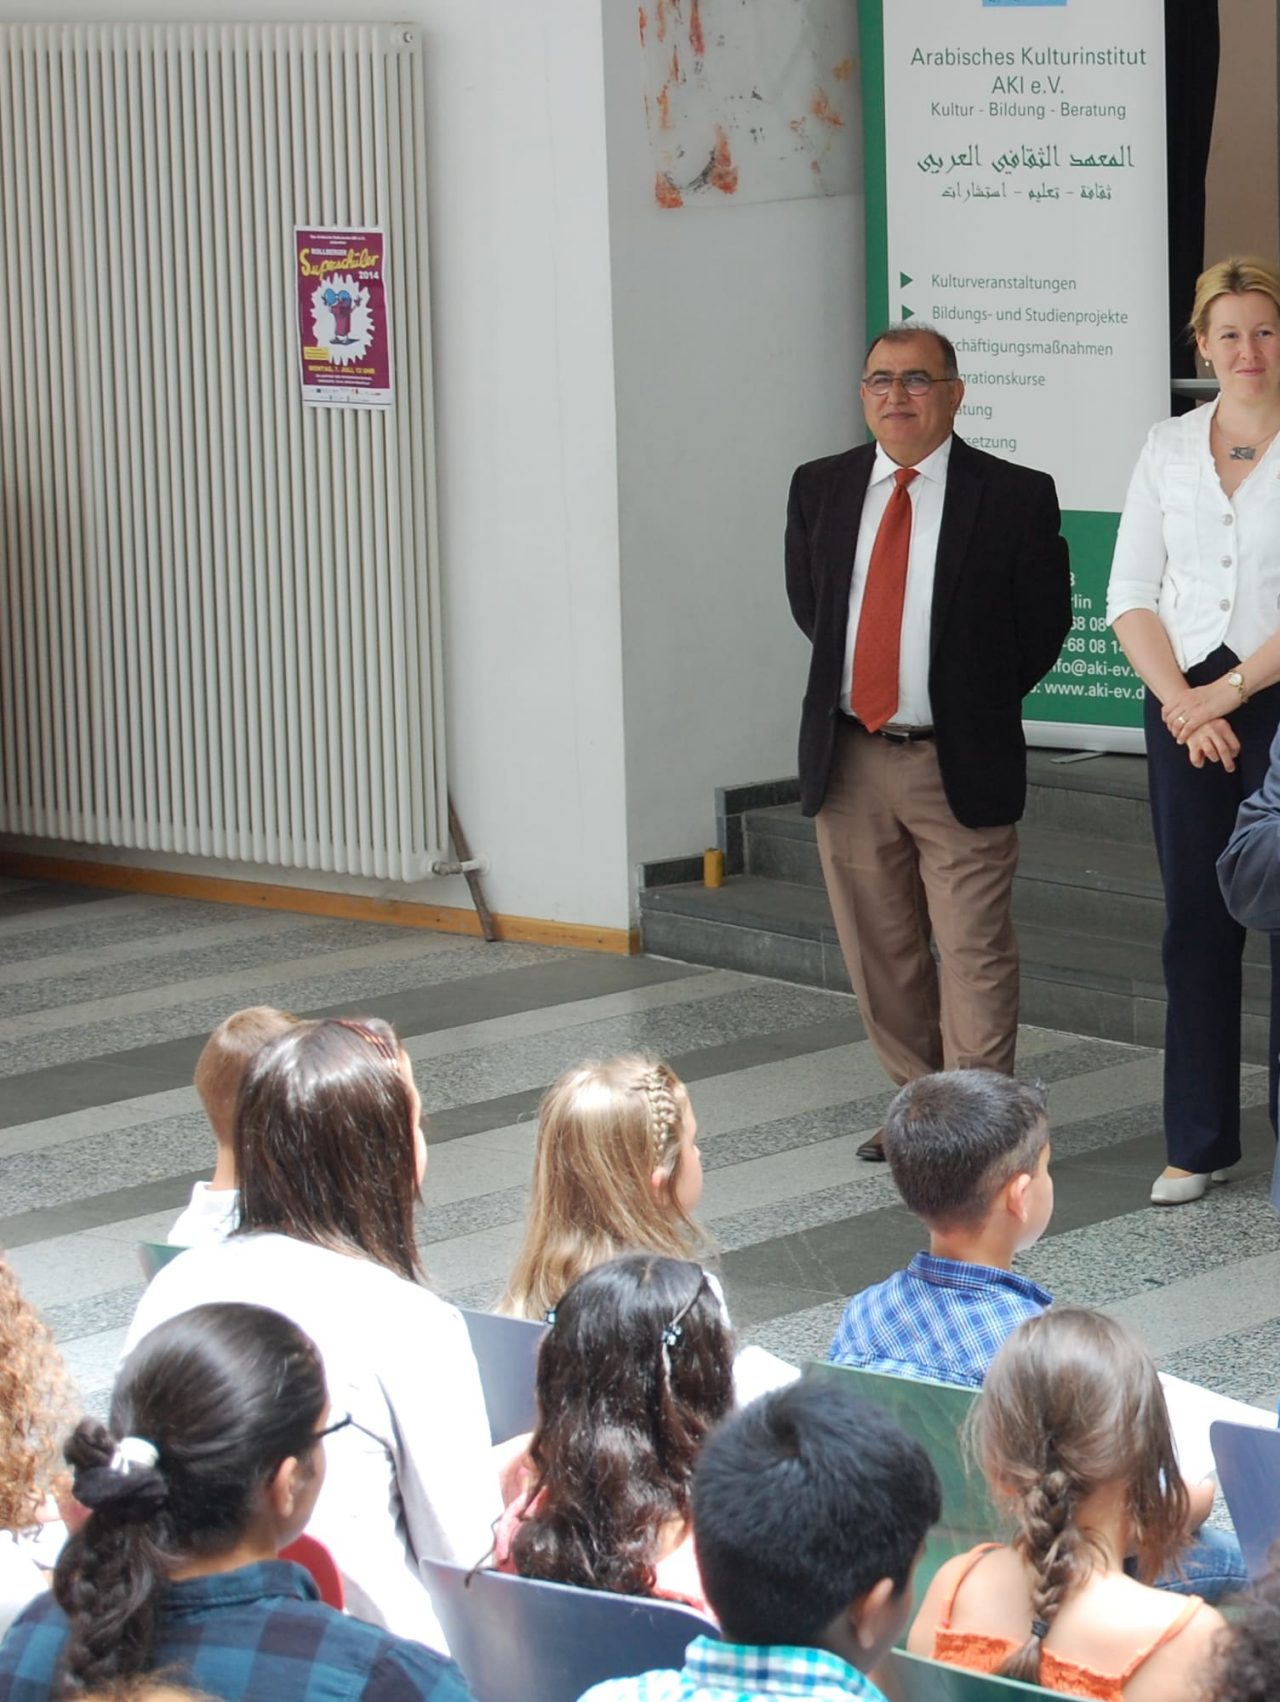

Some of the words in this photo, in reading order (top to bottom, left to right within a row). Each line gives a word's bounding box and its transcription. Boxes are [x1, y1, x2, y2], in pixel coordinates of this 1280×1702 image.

[910, 47, 1015, 66] Arabisches
[1021, 47, 1147, 66] Kulturinstitut
[991, 76, 1025, 95] AKI
[1030, 76, 1065, 95] e.V.
[931, 102, 974, 117] Kultur
[988, 102, 1046, 120] Bildung
[1060, 102, 1127, 120] Beratung
[917, 145, 982, 174] العربي
[1069, 145, 1135, 168] المعهد
[358, 270, 379, 280] 2014
[931, 274, 1077, 293] Kulturveranstaltungen
[932, 306, 992, 324] Bildungs-
[996, 307, 1022, 321] und
[1025, 307, 1128, 326] Studienprojekte
[951, 338, 1113, 357] chäftigungsmaßnahmen
[1089, 617, 1107, 632] 08
[1089, 639, 1106, 654] 08
[1044, 682, 1145, 699] www.aki-ev.d
